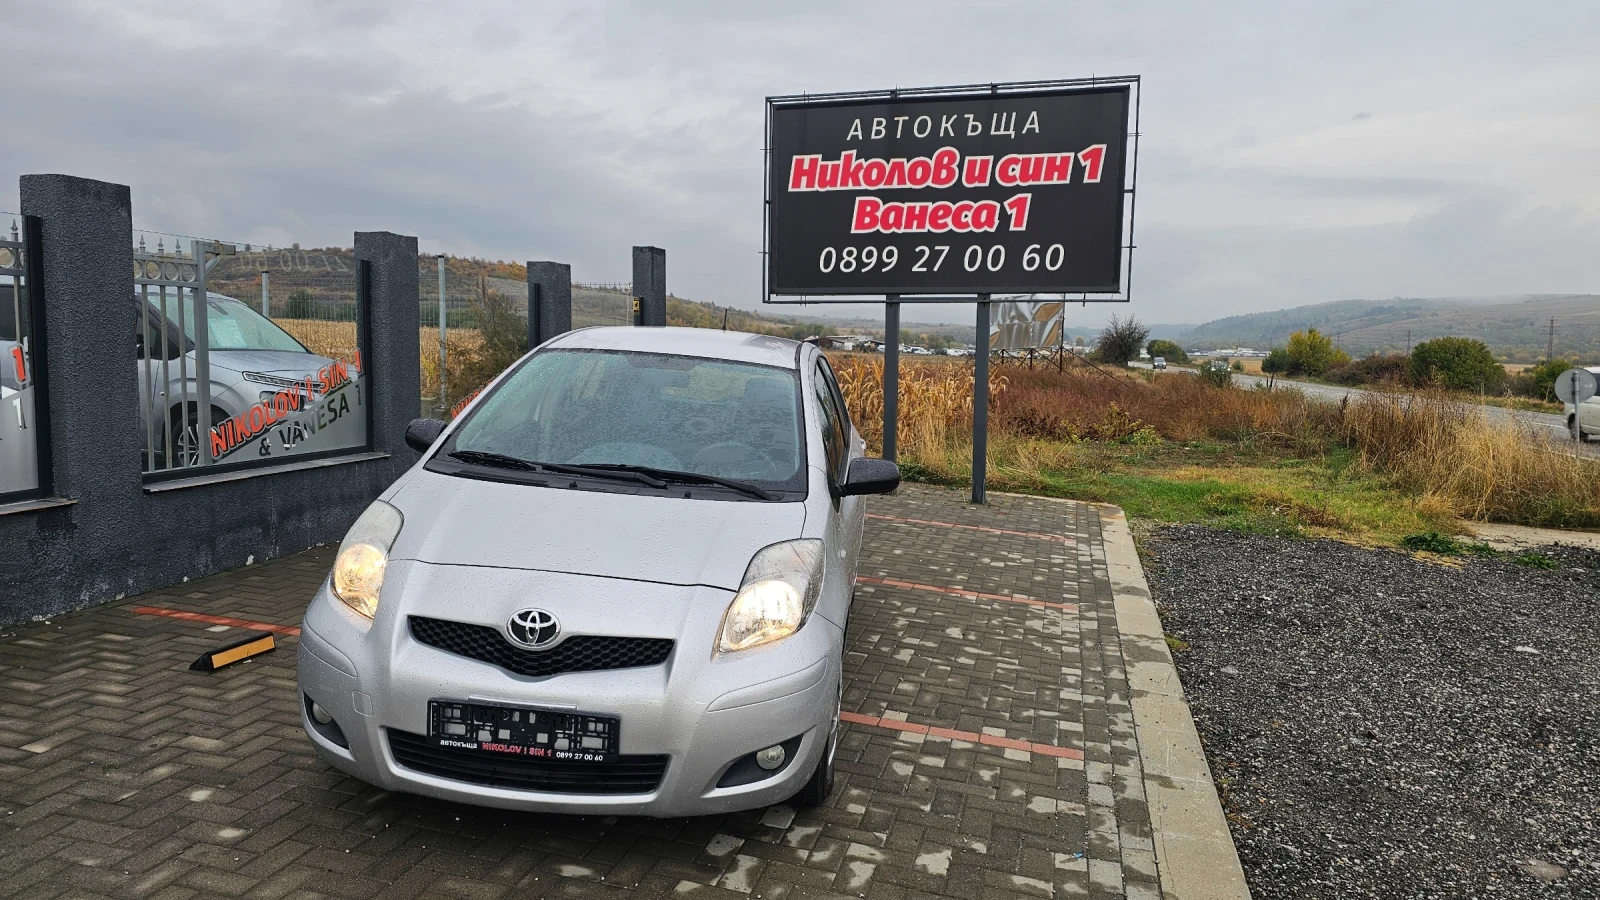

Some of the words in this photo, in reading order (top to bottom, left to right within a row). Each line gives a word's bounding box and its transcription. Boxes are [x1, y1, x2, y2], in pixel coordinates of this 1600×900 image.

[846, 110, 1041, 140] АВТОКЪЩА
[788, 146, 960, 192] Николов
[962, 155, 994, 187] и
[996, 151, 1075, 186] син
[1078, 144, 1107, 183] 1
[850, 196, 1001, 234] Ванеса
[1004, 193, 1032, 231] 1
[819, 246, 898, 273] 0899
[911, 245, 949, 272] 27
[963, 244, 1005, 271] 00
[1022, 243, 1065, 271] 60
[209, 382, 300, 457] NIKOLOV
[304, 376, 314, 402] I
[317, 356, 350, 395] SIN
[259, 437, 271, 457] &
[278, 393, 350, 451] VANESA
[355, 383, 363, 406] 1
[440, 739, 478, 749] автокъща
[482, 742, 522, 754] NIKOLOV
[529, 747, 545, 756] SIN
[556, 751, 573, 759] 0899
